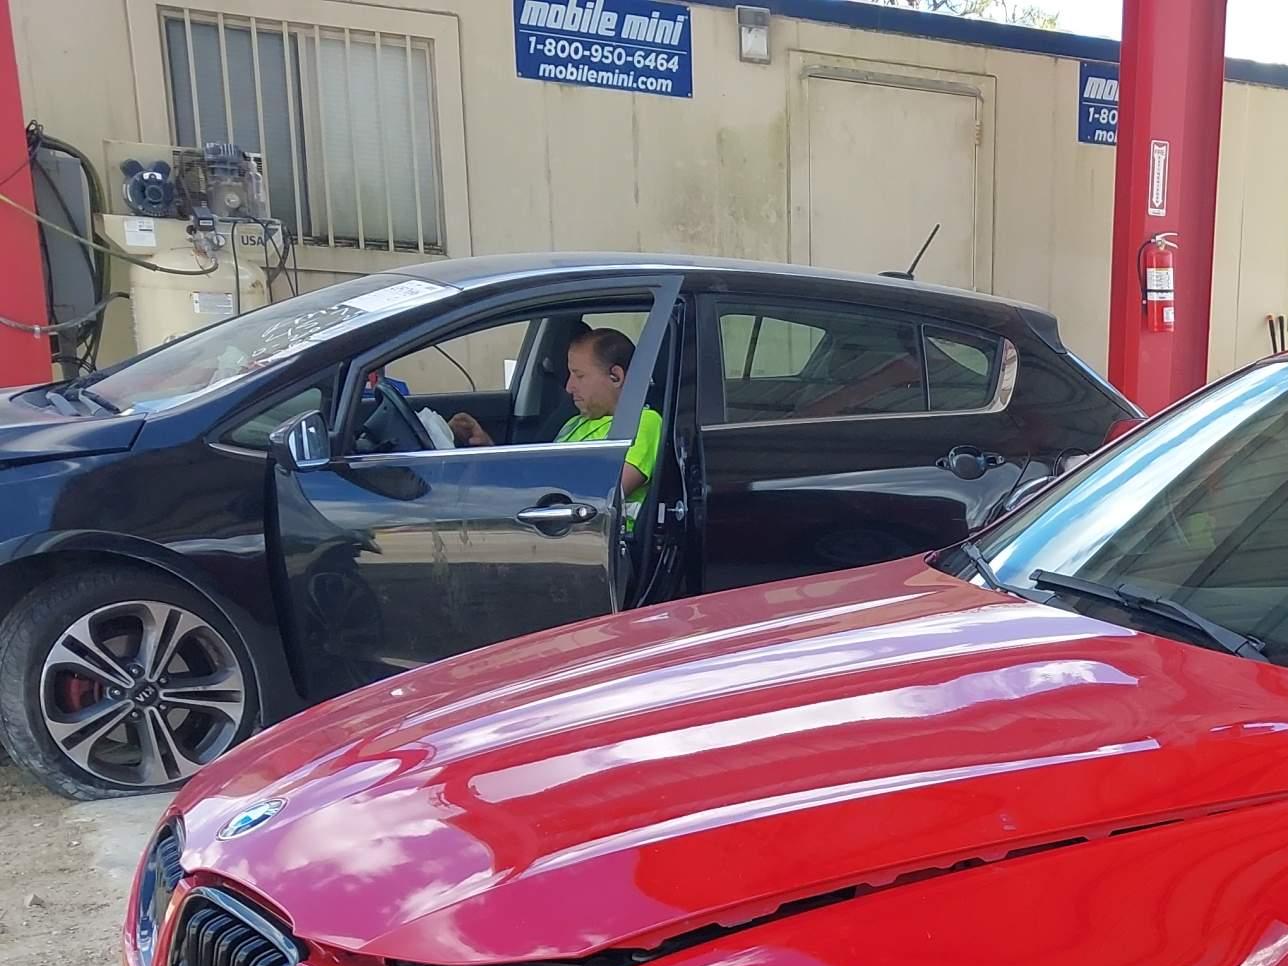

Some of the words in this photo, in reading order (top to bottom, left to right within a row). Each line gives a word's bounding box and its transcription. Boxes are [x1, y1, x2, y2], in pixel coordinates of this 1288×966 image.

[520, 0, 618, 36] mobile
[621, 11, 685, 45] mini
[528, 36, 679, 73] 1-800-950-6464
[539, 63, 673, 93] mobilemini.com
[1094, 129, 1117, 143] mo
[241, 235, 265, 246] USA
[135, 685, 155, 702] KIA
